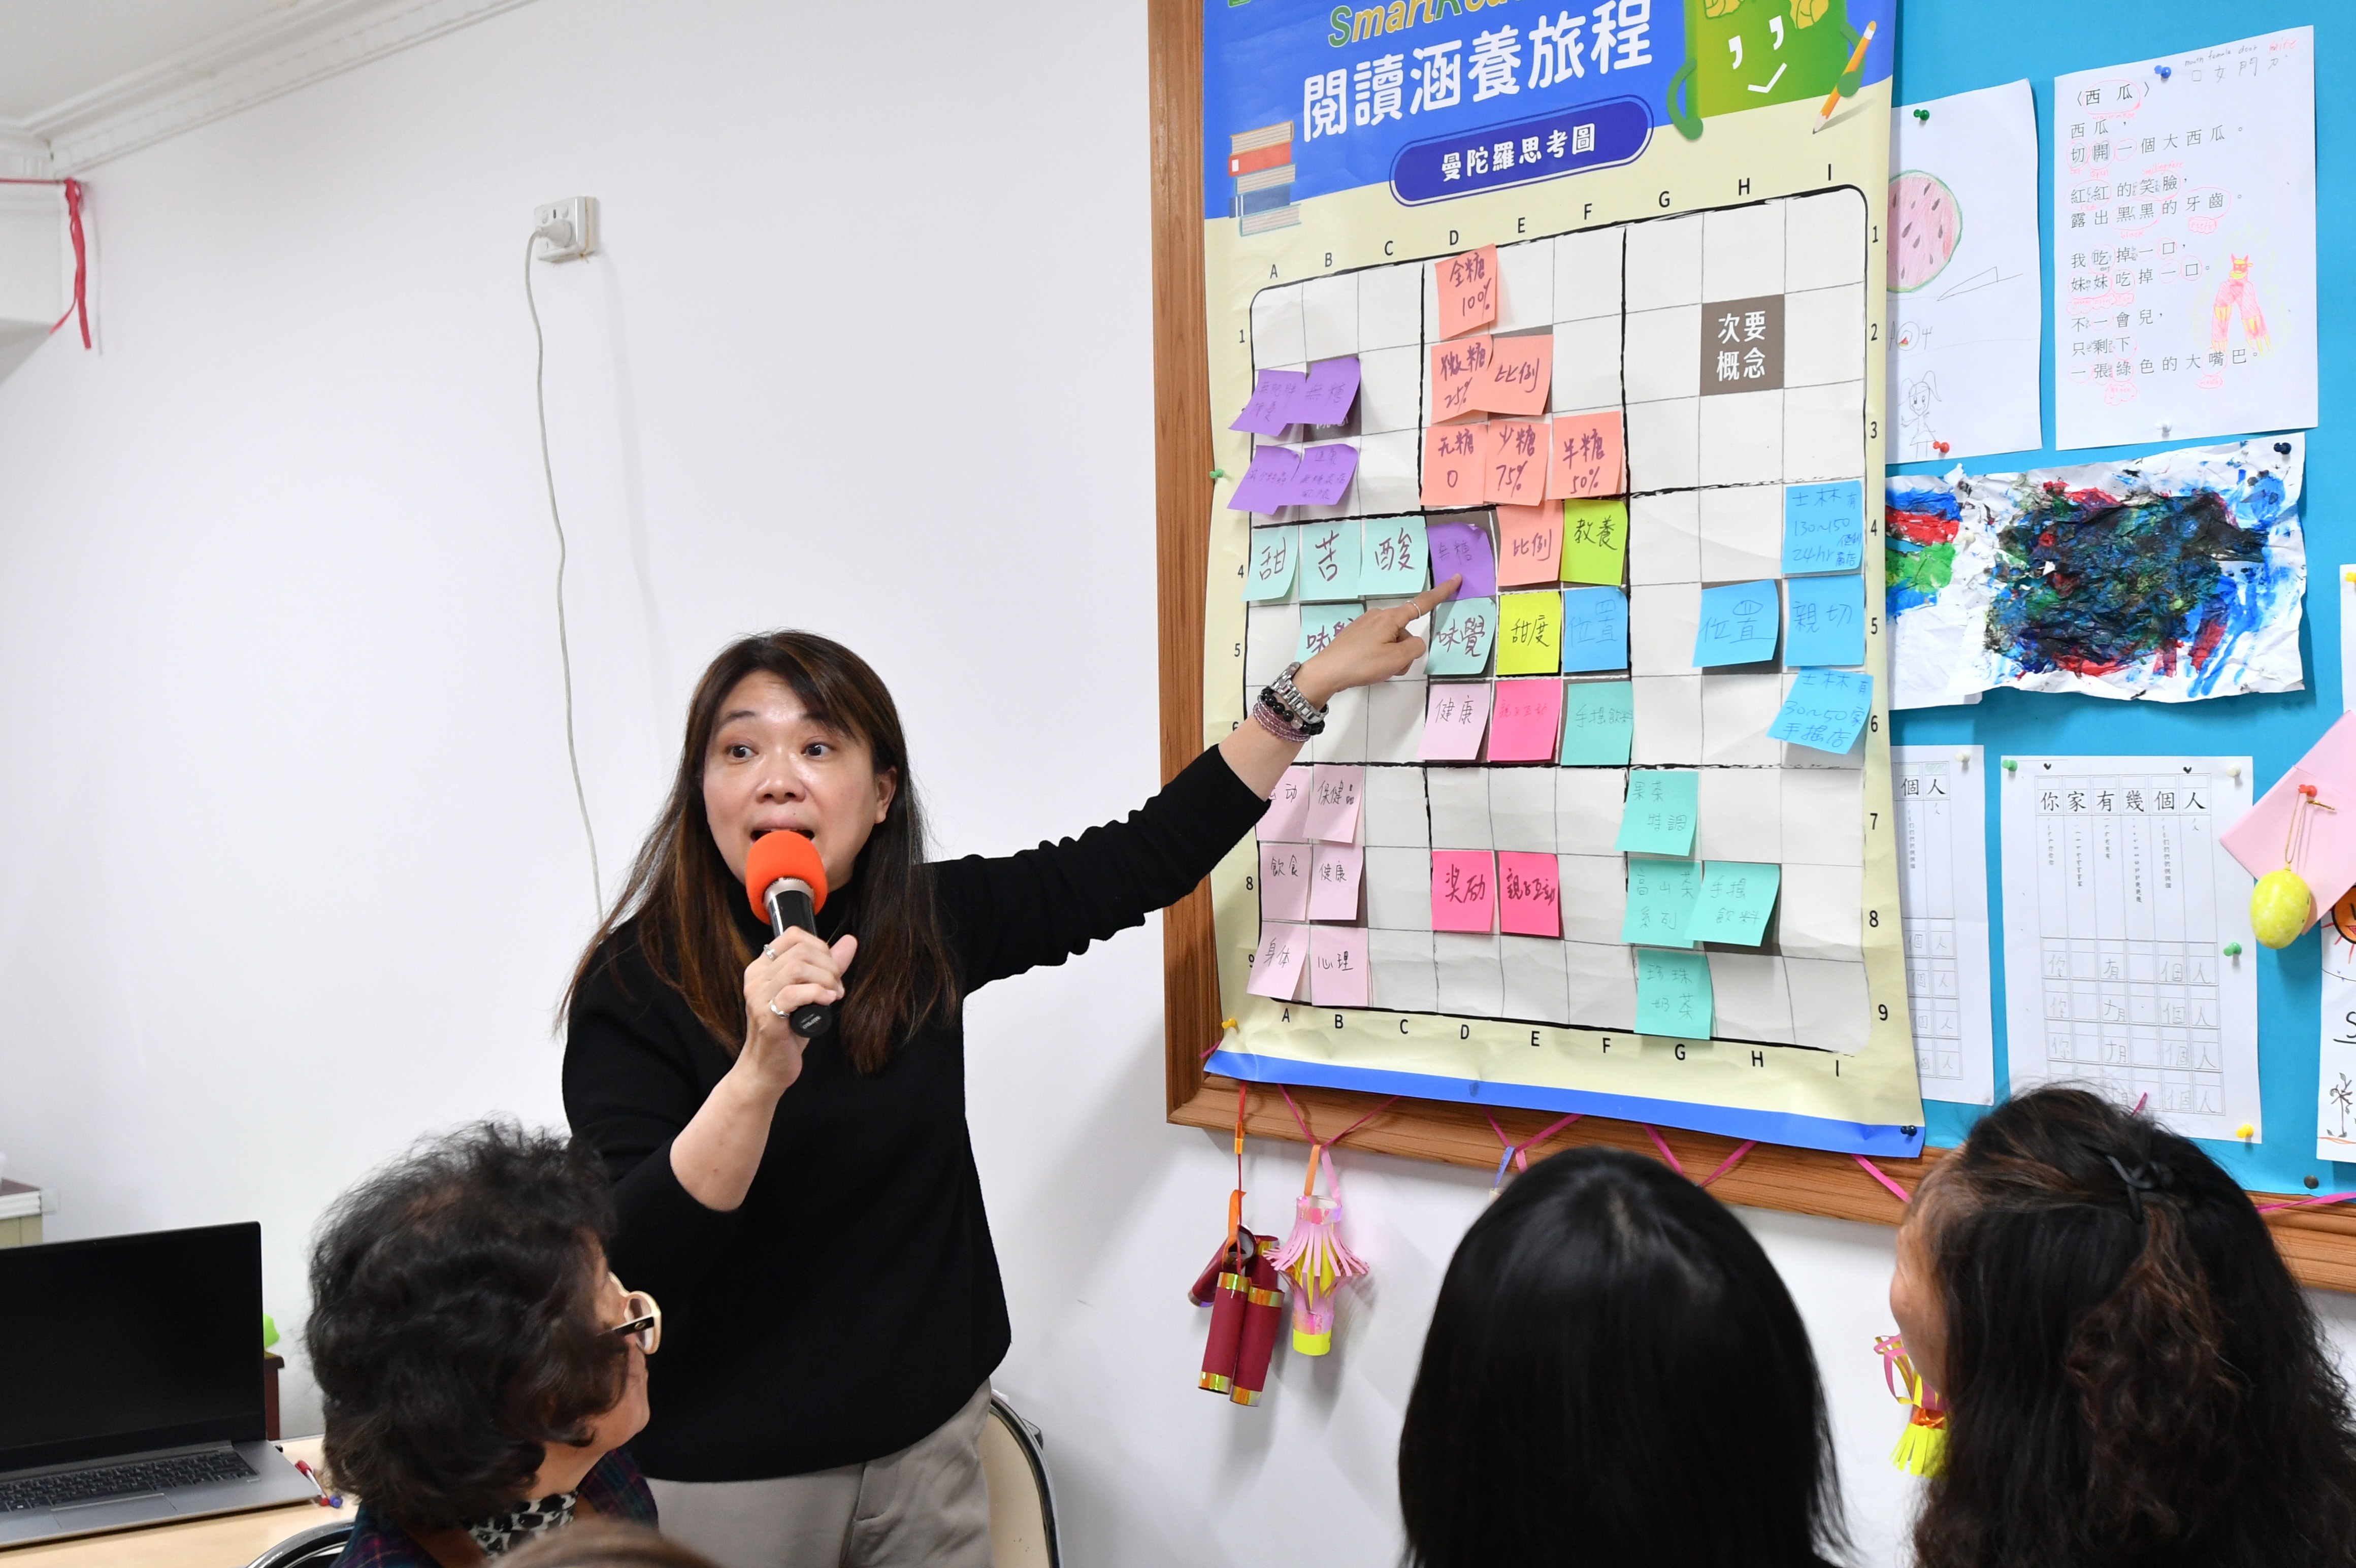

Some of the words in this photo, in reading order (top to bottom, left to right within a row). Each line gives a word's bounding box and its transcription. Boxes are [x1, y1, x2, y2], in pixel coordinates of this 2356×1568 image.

[1303, 0, 1653, 143] 閱讀涵養旅程
[1441, 123, 1595, 182] 曼陀羅思考圖
[1739, 178, 1750, 195] H
[1659, 191, 1670, 208] G
[1584, 204, 1592, 220] F
[1518, 218, 1526, 233] E
[1872, 225, 1878, 243] 1
[1450, 231, 1459, 246] D
[1384, 241, 1393, 255] C
[1325, 252, 1332, 267] B
[1270, 264, 1278, 279] A
[1450, 252, 1485, 287] 全糖
[1462, 278, 1492, 321] 100%
[1239, 329, 1246, 343] 1
[1718, 310, 1766, 344] 次要
[1871, 323, 1878, 341] 2
[2072, 336, 2131, 357] 只剩下
[1441, 342, 1486, 381] 微糖
[1716, 347, 1765, 382] 概念
[1494, 358, 1540, 393] 比例
[1444, 377, 1473, 412] 25%
[1870, 421, 1878, 439] 3
[1497, 424, 1535, 456] 少糖
[1563, 429, 1606, 469] 半糖
[1496, 461, 1528, 498] 75%
[1570, 466, 1600, 495] 50%
[1574, 515, 1618, 550] 教養
[1870, 519, 1878, 536] 4
[1375, 527, 1415, 571] 酸
[1513, 529, 1553, 561] 比例
[1259, 536, 1287, 580] 甜
[1315, 530, 1339, 581] 苦
[1237, 564, 1244, 578] 4
[1567, 599, 1618, 648] 位置
[1698, 600, 1776, 644] 位置
[1792, 601, 1853, 633] 親切
[1871, 617, 1878, 635] 5
[1436, 615, 1485, 657] 味覺
[1511, 615, 1551, 647] 甜度
[1234, 643, 1240, 657] 5
[1435, 695, 1474, 725] 健康
[1871, 715, 1878, 732] 6
[1901, 778, 1946, 796] 個人
[2040, 790, 2207, 813] 你家有幾個人
[1870, 813, 1878, 830] 7
[1271, 854, 1299, 877] 飲食
[1319, 860, 1347, 883] 健康
[1246, 876, 1254, 891] 8
[1640, 906, 1676, 930] 系列
[1716, 907, 1761, 924] 飲料
[1870, 910, 1879, 928] 8
[1317, 951, 1354, 971] 心理
[1282, 1008, 1290, 1023] A
[1334, 1014, 1344, 1029] B
[1879, 1004, 1888, 1021] 9
[1399, 1019, 1409, 1034] C
[1460, 1024, 1469, 1039] D
[1531, 1031, 1540, 1047] E
[1602, 1038, 1611, 1053] F
[1675, 1044, 1686, 1061] G
[1751, 1051, 1764, 1068] H
